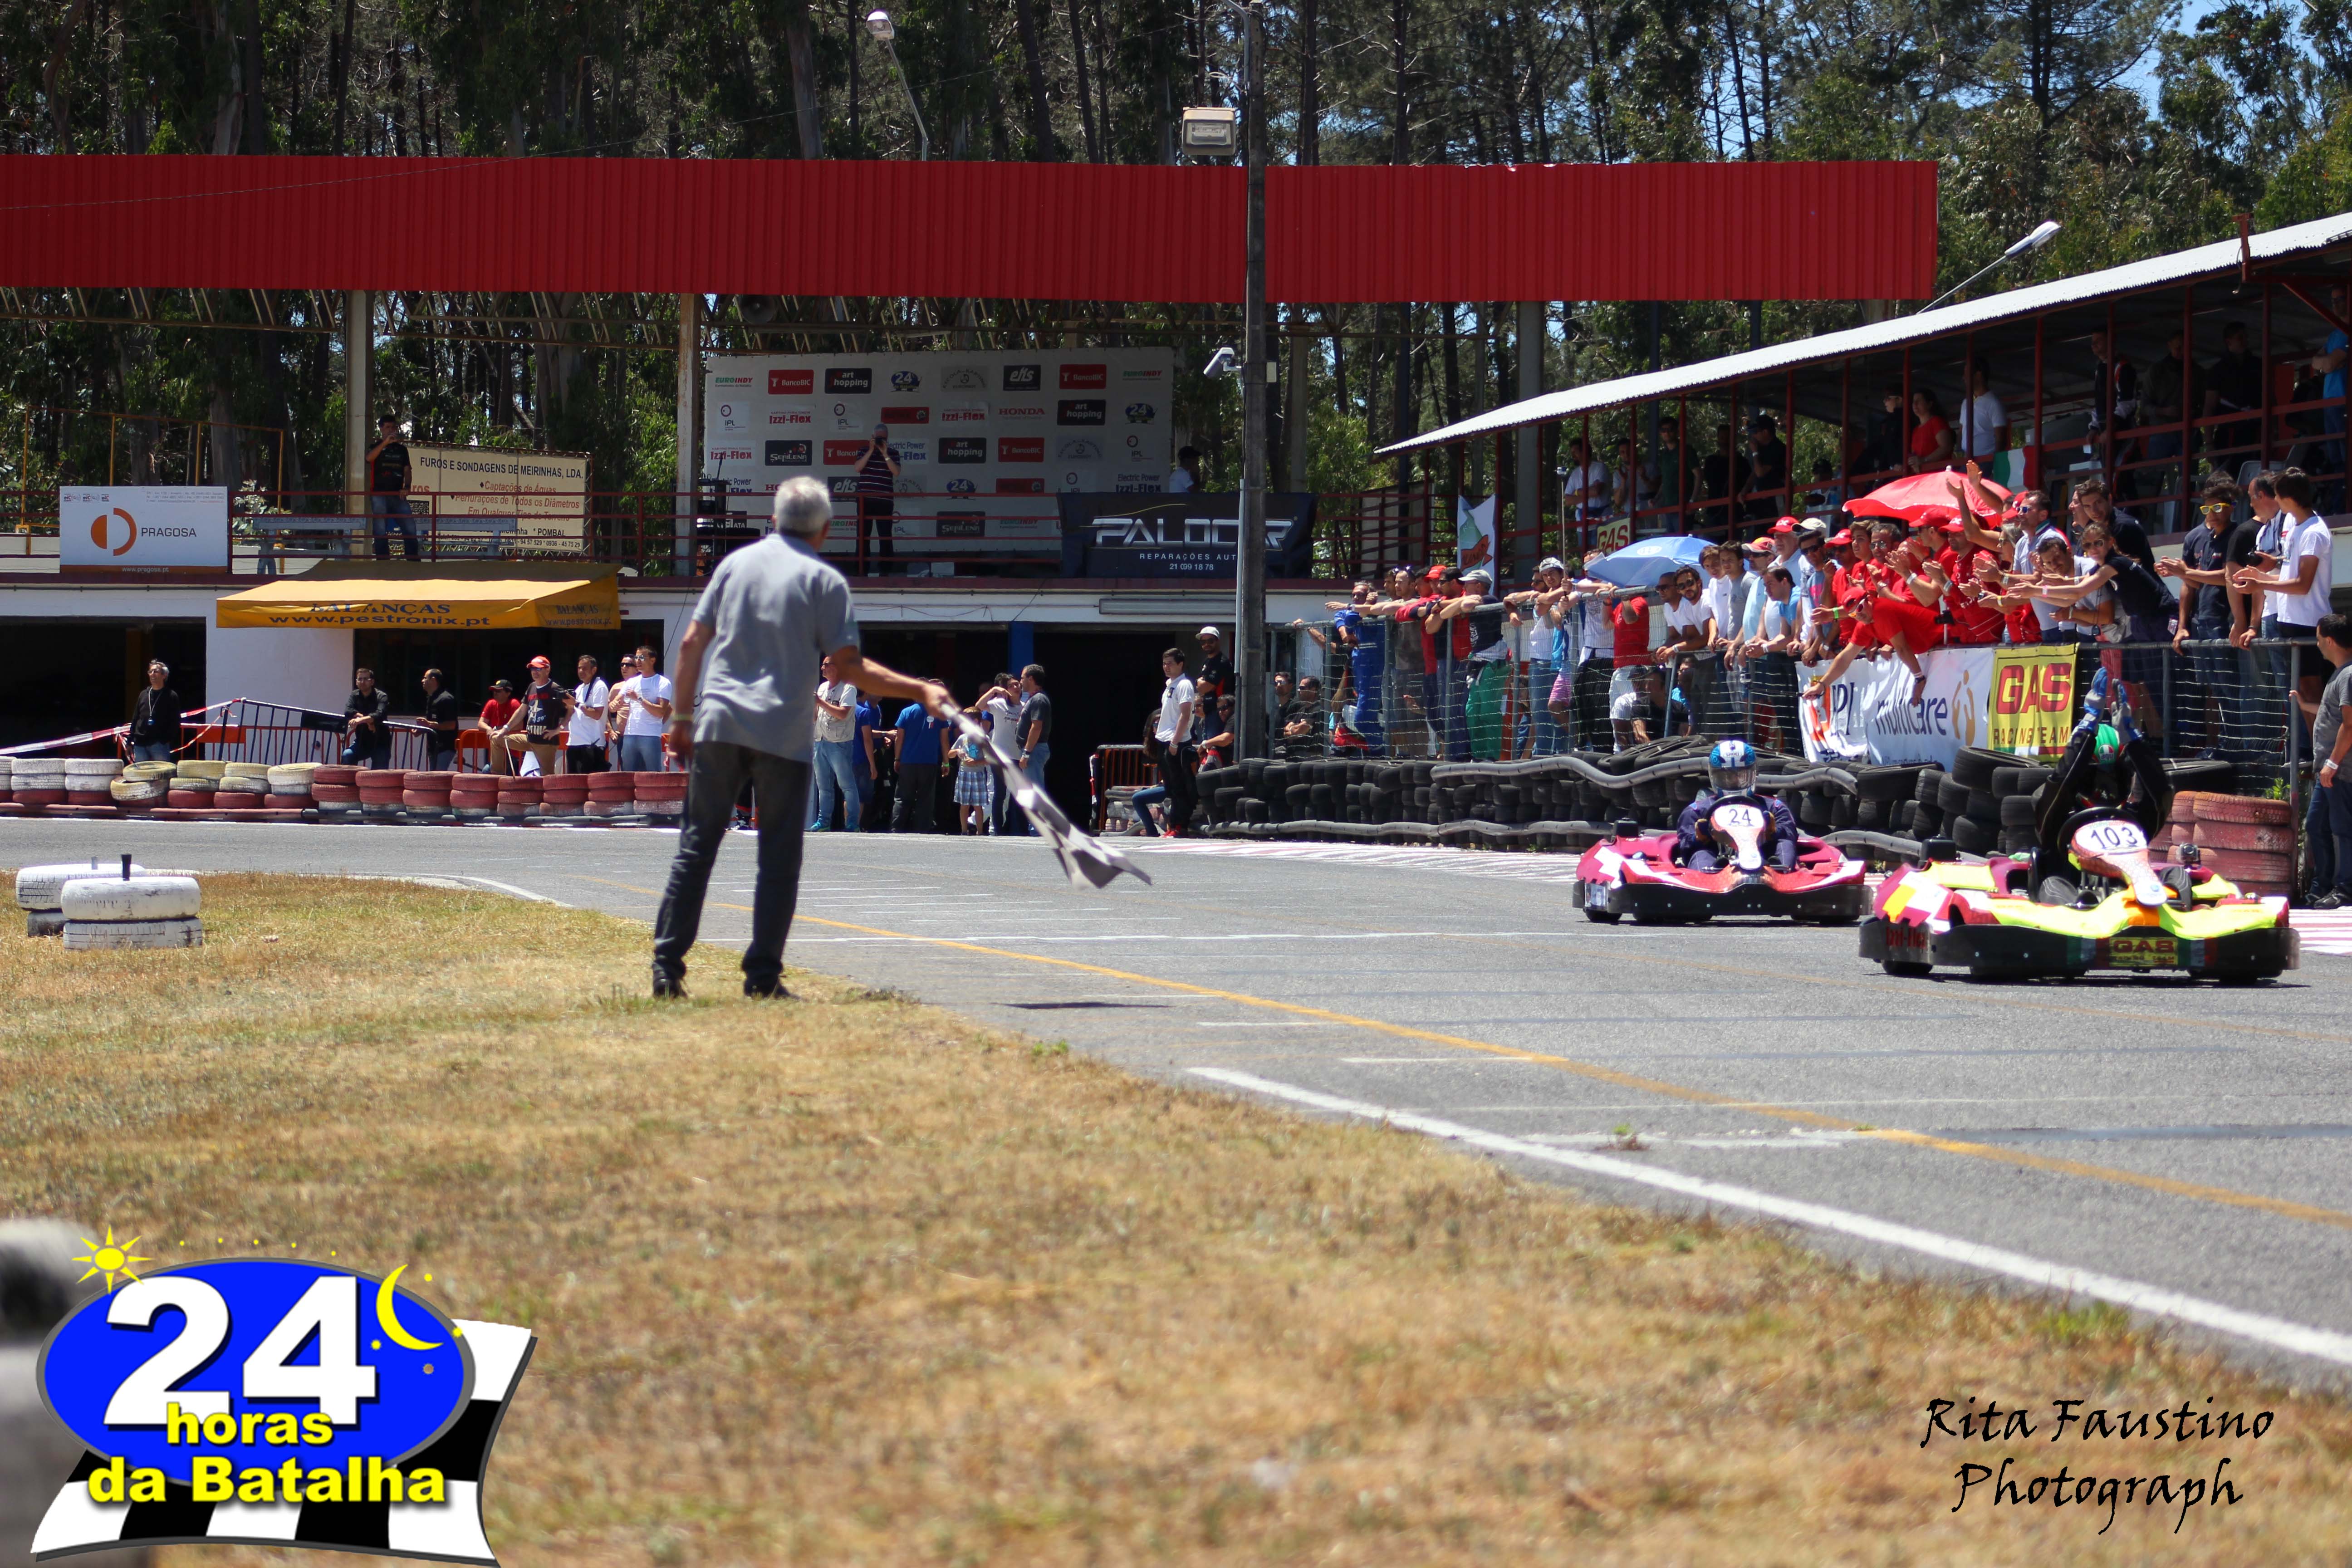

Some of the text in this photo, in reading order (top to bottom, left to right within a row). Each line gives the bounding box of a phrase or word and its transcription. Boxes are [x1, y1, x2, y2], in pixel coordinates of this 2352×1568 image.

[895, 372, 912, 383] 24
[1130, 405, 1147, 415] 24
[769, 415, 811, 424] Izzi-Flex
[420, 457, 583, 479] FUROS E SONDAGENS DE MEIRINHAS, LDA.
[1117, 473, 1140, 481] Electric
[485, 480, 522, 492] Captações
[500, 496, 509, 504] de
[512, 496, 532, 506] Todos
[544, 498, 580, 509] Diâmetros
[468, 506, 480, 514] Em
[141, 528, 196, 537] PRAGOSA
[538, 528, 566, 536] POMBAL
[1092, 519, 1292, 549] PALOCR
[1597, 525, 1629, 552] GAS
[1140, 552, 1210, 561] REPARAÇÕES
[270, 615, 490, 627] www.pestronix.pt
[1996, 663, 2072, 715] GAS
[2037, 726, 2069, 744] EAM
[1729, 808, 1751, 825] 24
[2090, 826, 2138, 850] 103
[2113, 940, 2175, 953] GAS
